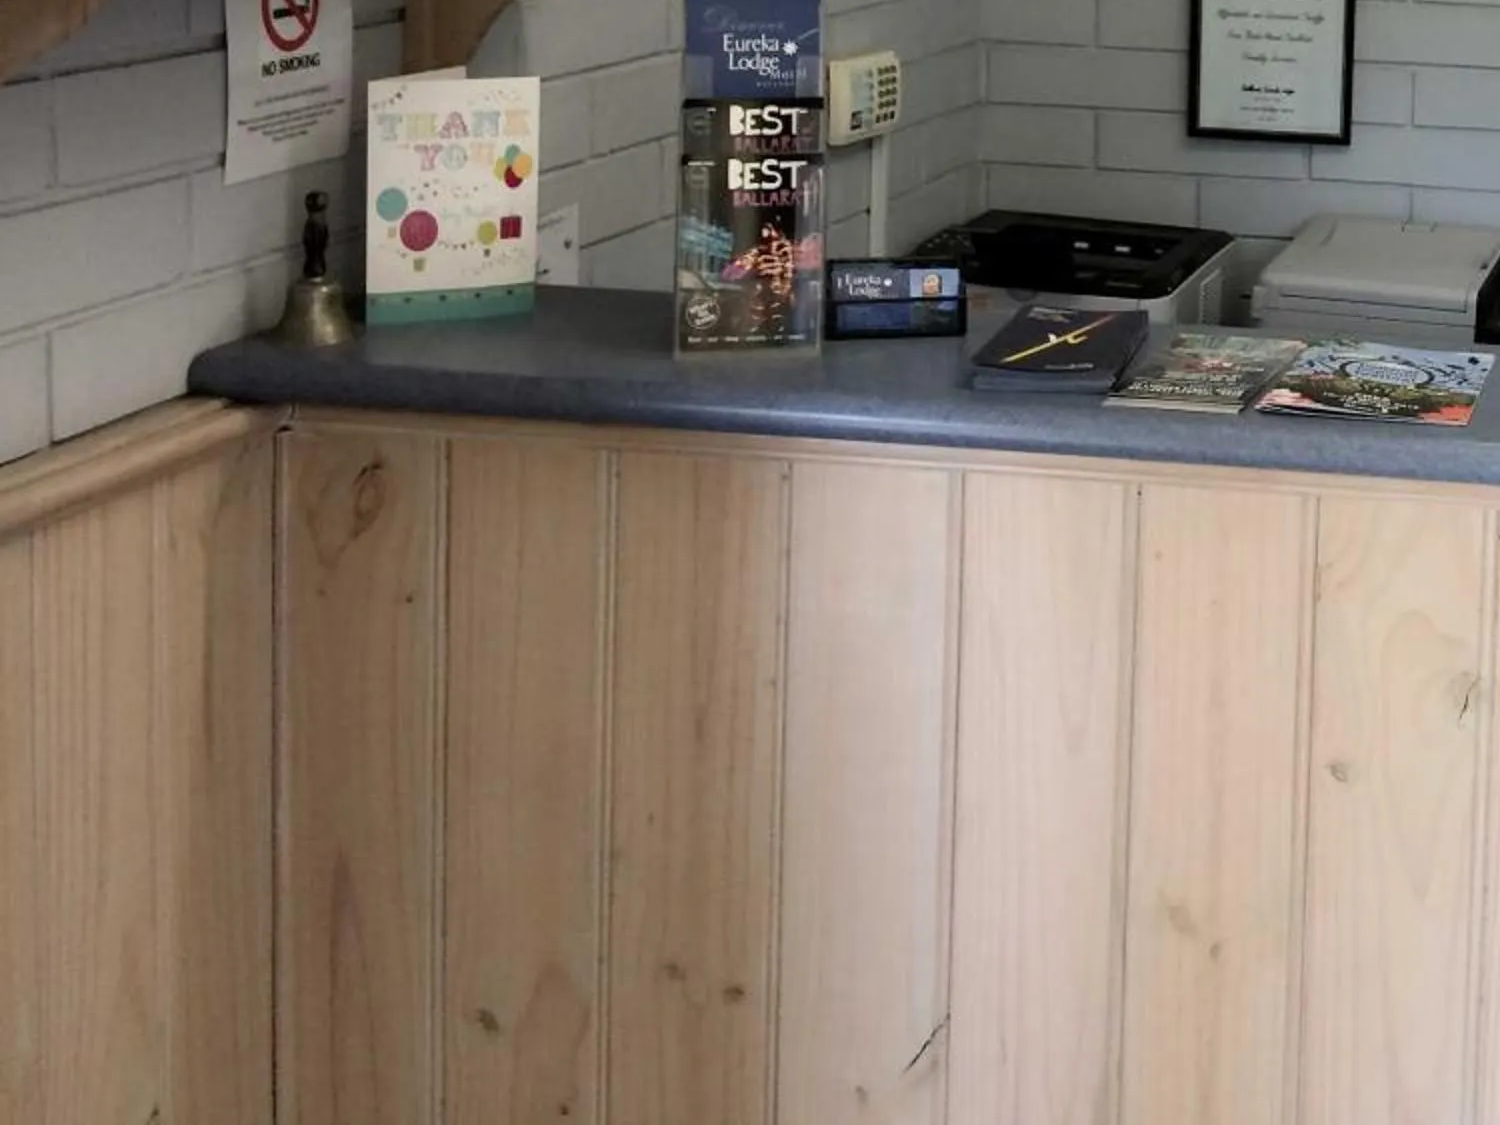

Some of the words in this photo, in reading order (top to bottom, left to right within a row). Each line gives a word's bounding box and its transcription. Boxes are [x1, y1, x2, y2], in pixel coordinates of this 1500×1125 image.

[723, 33, 779, 52] Eureka
[262, 60, 277, 77] NO
[279, 52, 320, 74] SMOKING
[729, 52, 780, 75] Lodge
[728, 105, 809, 135] BEST
[727, 158, 808, 189] BEST
